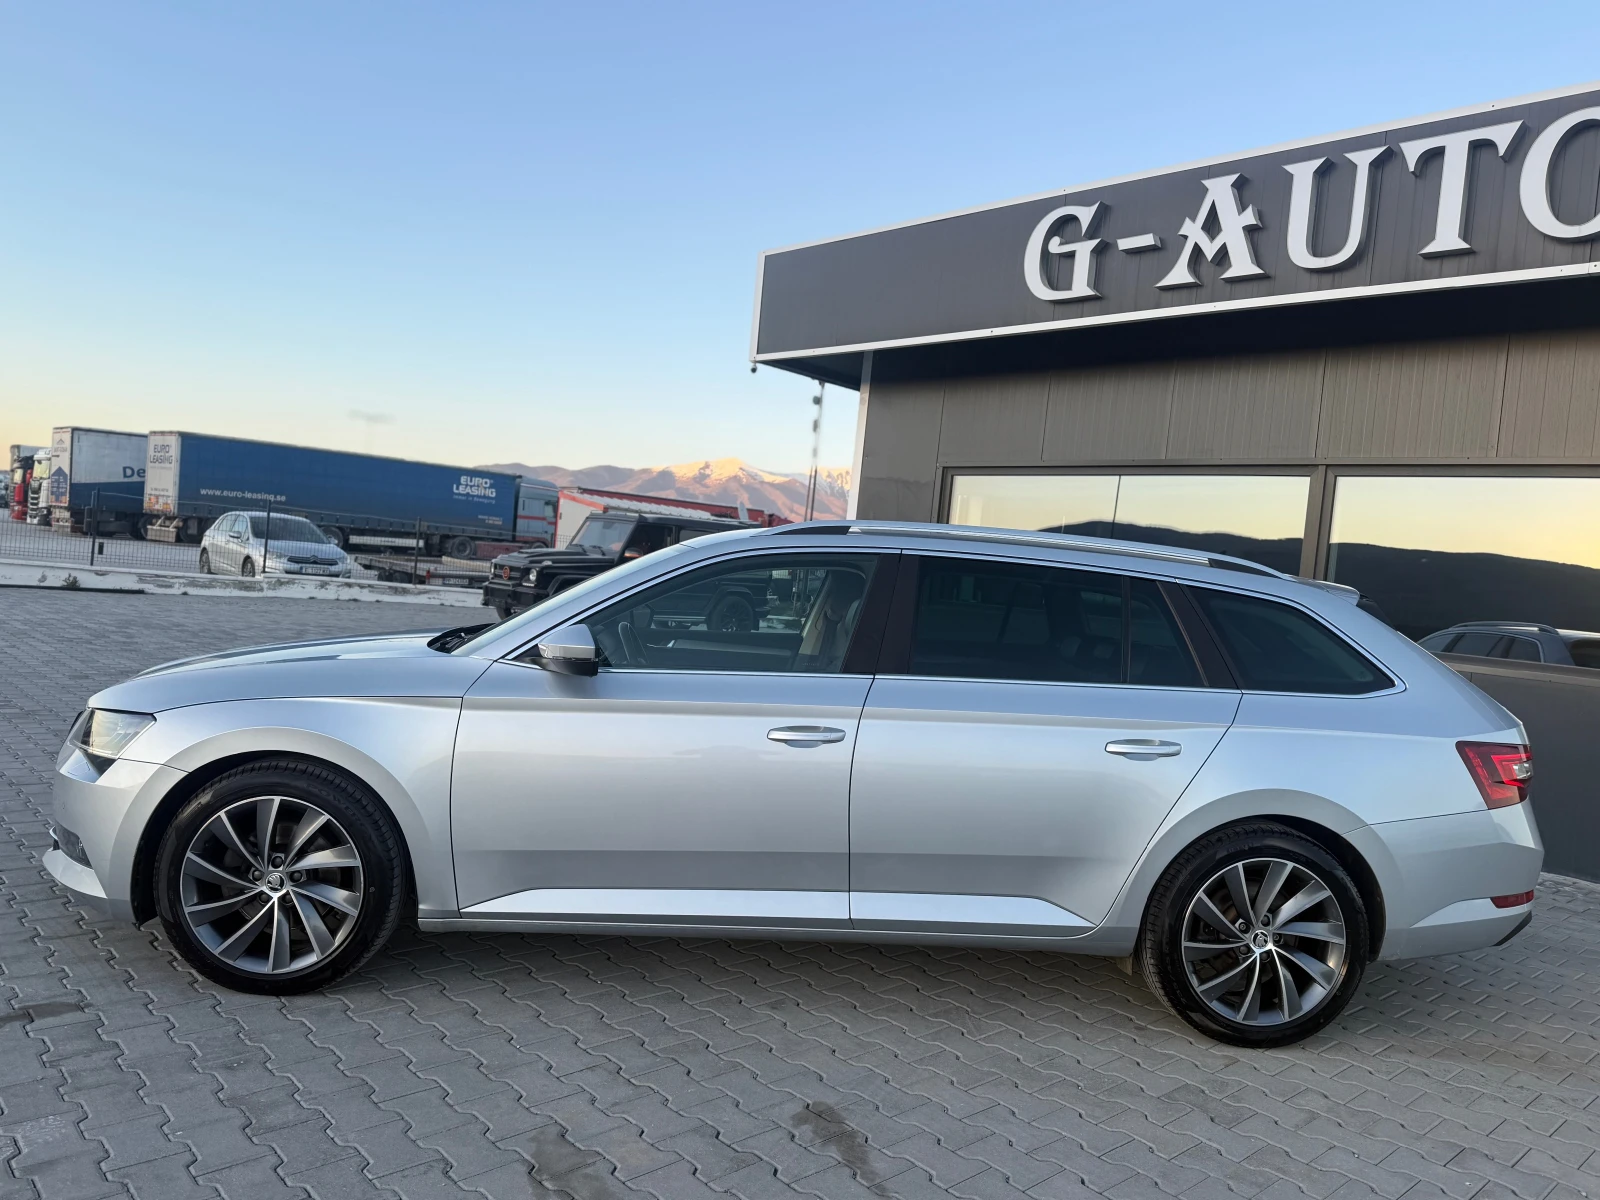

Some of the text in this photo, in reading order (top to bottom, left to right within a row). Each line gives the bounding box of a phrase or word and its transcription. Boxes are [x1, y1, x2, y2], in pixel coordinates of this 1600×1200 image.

[1023, 105, 1600, 302] G-AUTO
[153, 444, 170, 454] EURO
[149, 454, 173, 465] LEASING
[460, 475, 490, 488] EURO
[200, 488, 287, 502] www.euro-leasing.se
[453, 483, 496, 498] LEASING
